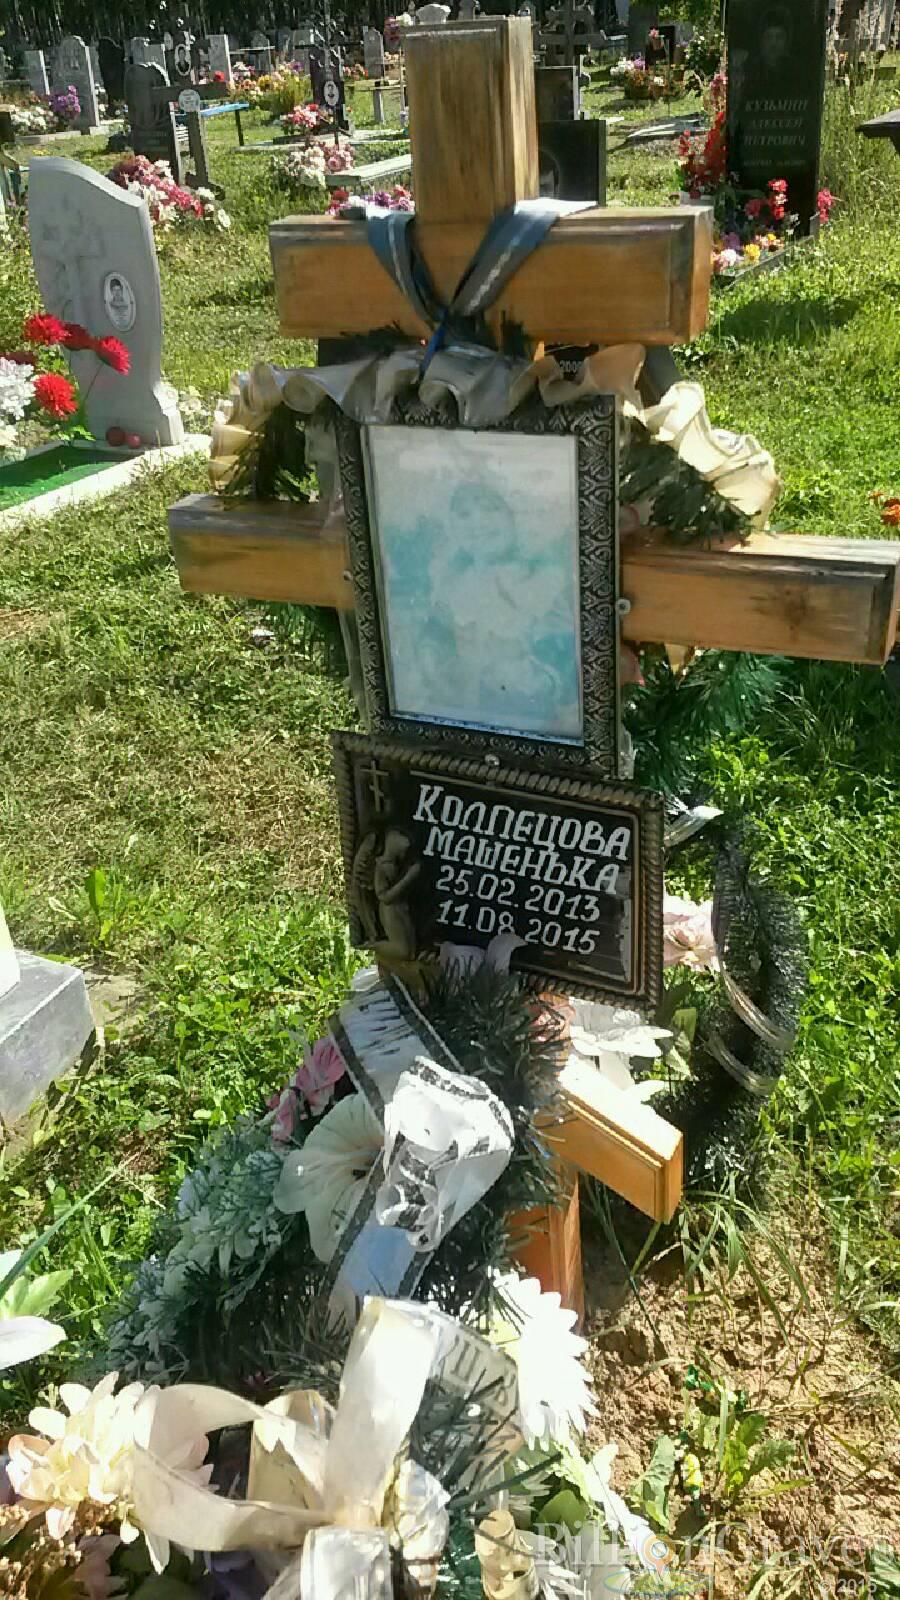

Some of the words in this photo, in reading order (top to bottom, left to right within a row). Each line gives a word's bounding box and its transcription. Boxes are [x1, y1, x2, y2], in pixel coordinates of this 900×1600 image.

[412, 784, 631, 861] КОЛПЕЦОВА
[423, 826, 620, 895] МАШЕНЬКА
[435, 865, 601, 922] 25.02.2013
[435, 900, 601, 955] 11.082015
